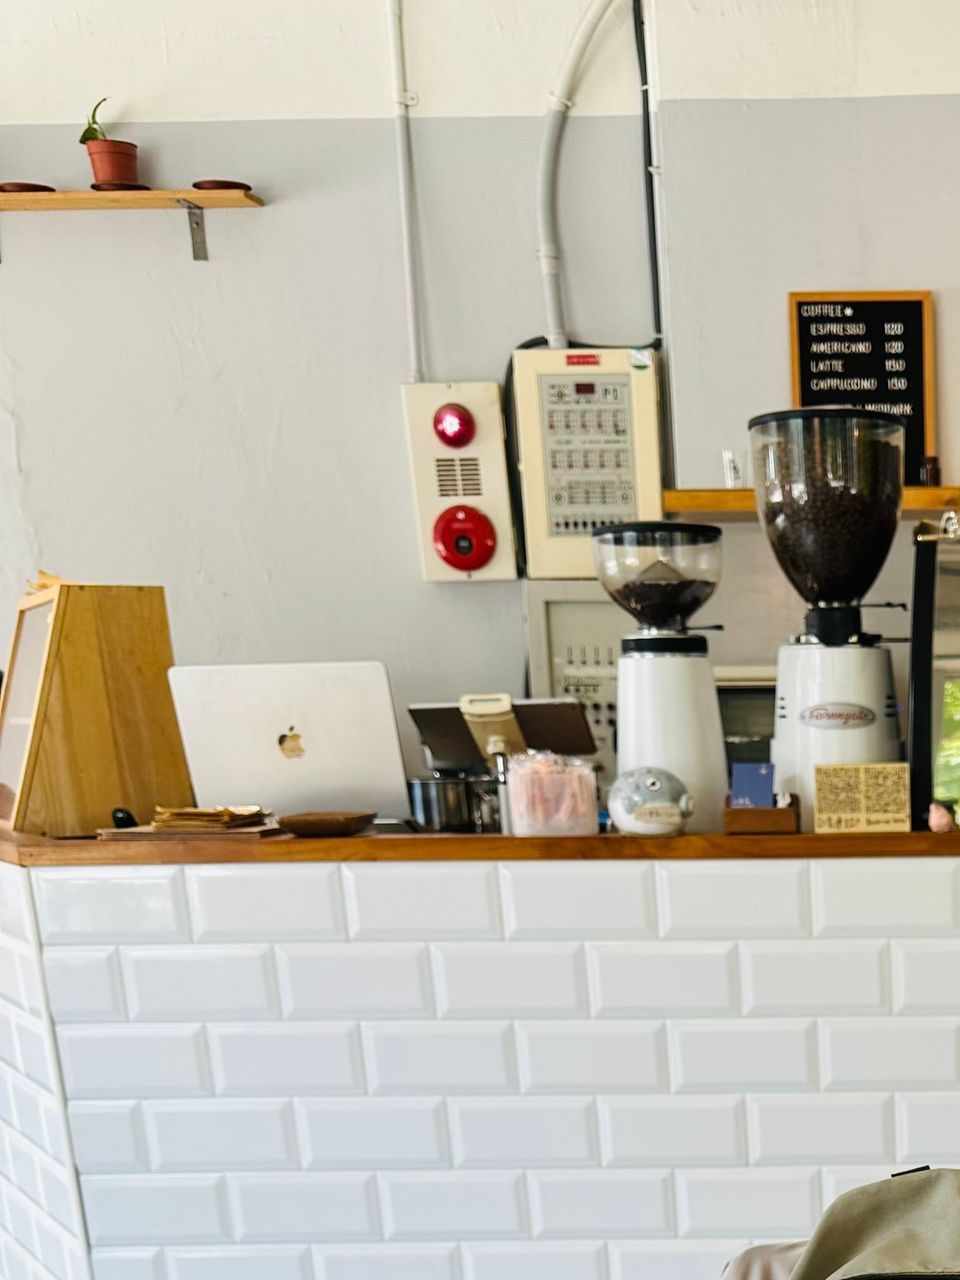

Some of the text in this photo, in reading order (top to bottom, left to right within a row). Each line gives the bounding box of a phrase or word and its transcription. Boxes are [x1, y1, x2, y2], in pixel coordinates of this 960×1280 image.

[800, 304, 844, 317] COFFEE
[810, 323, 866, 336] ESPRESSO
[810, 342, 872, 354] AMERICANO
[810, 359, 844, 372] LATTE
[810, 378, 877, 391] CAPPUCCINO
